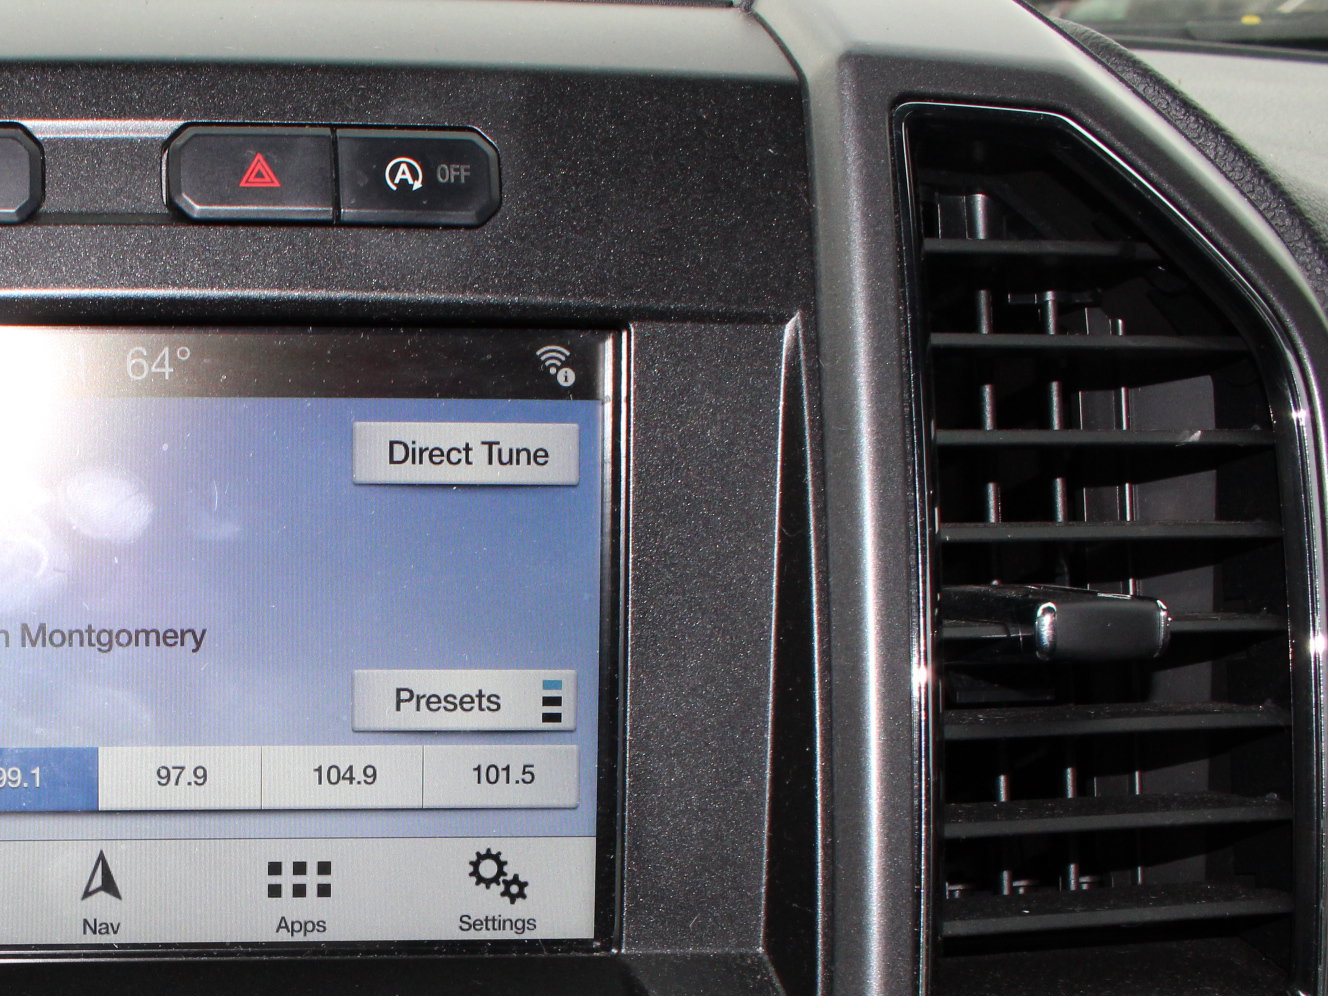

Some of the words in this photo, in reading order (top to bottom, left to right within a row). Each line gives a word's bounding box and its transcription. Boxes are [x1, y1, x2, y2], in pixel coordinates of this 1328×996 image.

[436, 164, 471, 184] OFF
[387, 440, 473, 466] Direct
[480, 440, 550, 467] Tune
[20, 622, 208, 654] Montgomery
[394, 687, 502, 713] Presets
[156, 765, 208, 787] 97.9
[312, 764, 378, 786] 104.9
[471, 763, 536, 785] 101.5
[82, 918, 121, 936] Nav
[275, 916, 327, 938] Apps
[458, 913, 538, 937] Settings
